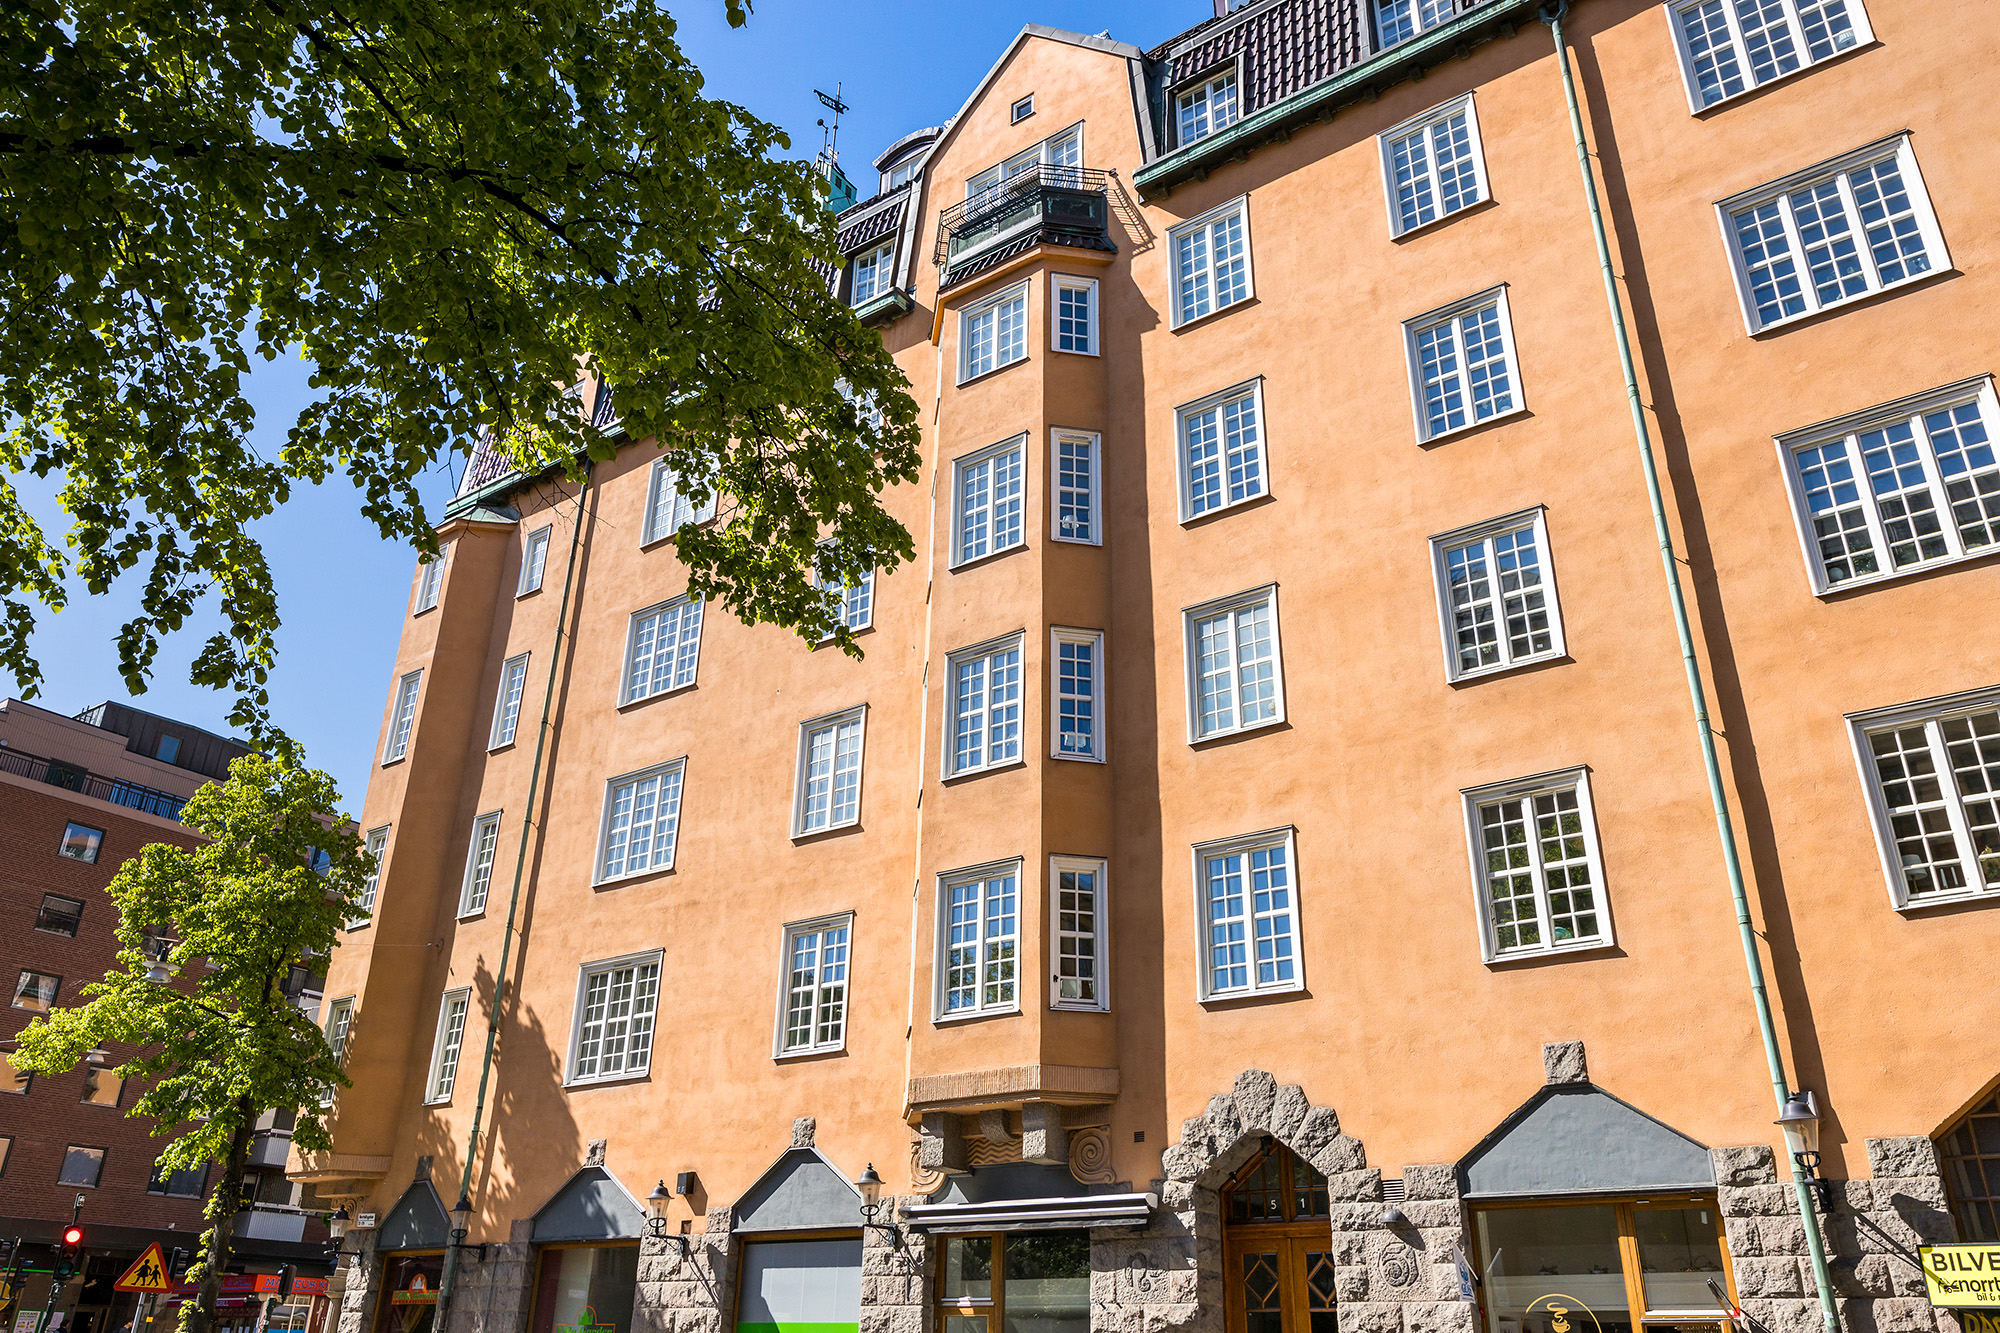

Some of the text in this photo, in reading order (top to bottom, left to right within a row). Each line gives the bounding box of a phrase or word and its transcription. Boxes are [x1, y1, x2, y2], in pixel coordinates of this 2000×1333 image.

[1931, 1252, 2000, 1271] BILVE
[233, 1276, 252, 1286] GRILL
[265, 1277, 317, 1289] MAEUS
[1976, 1293, 1996, 1301] bil &
